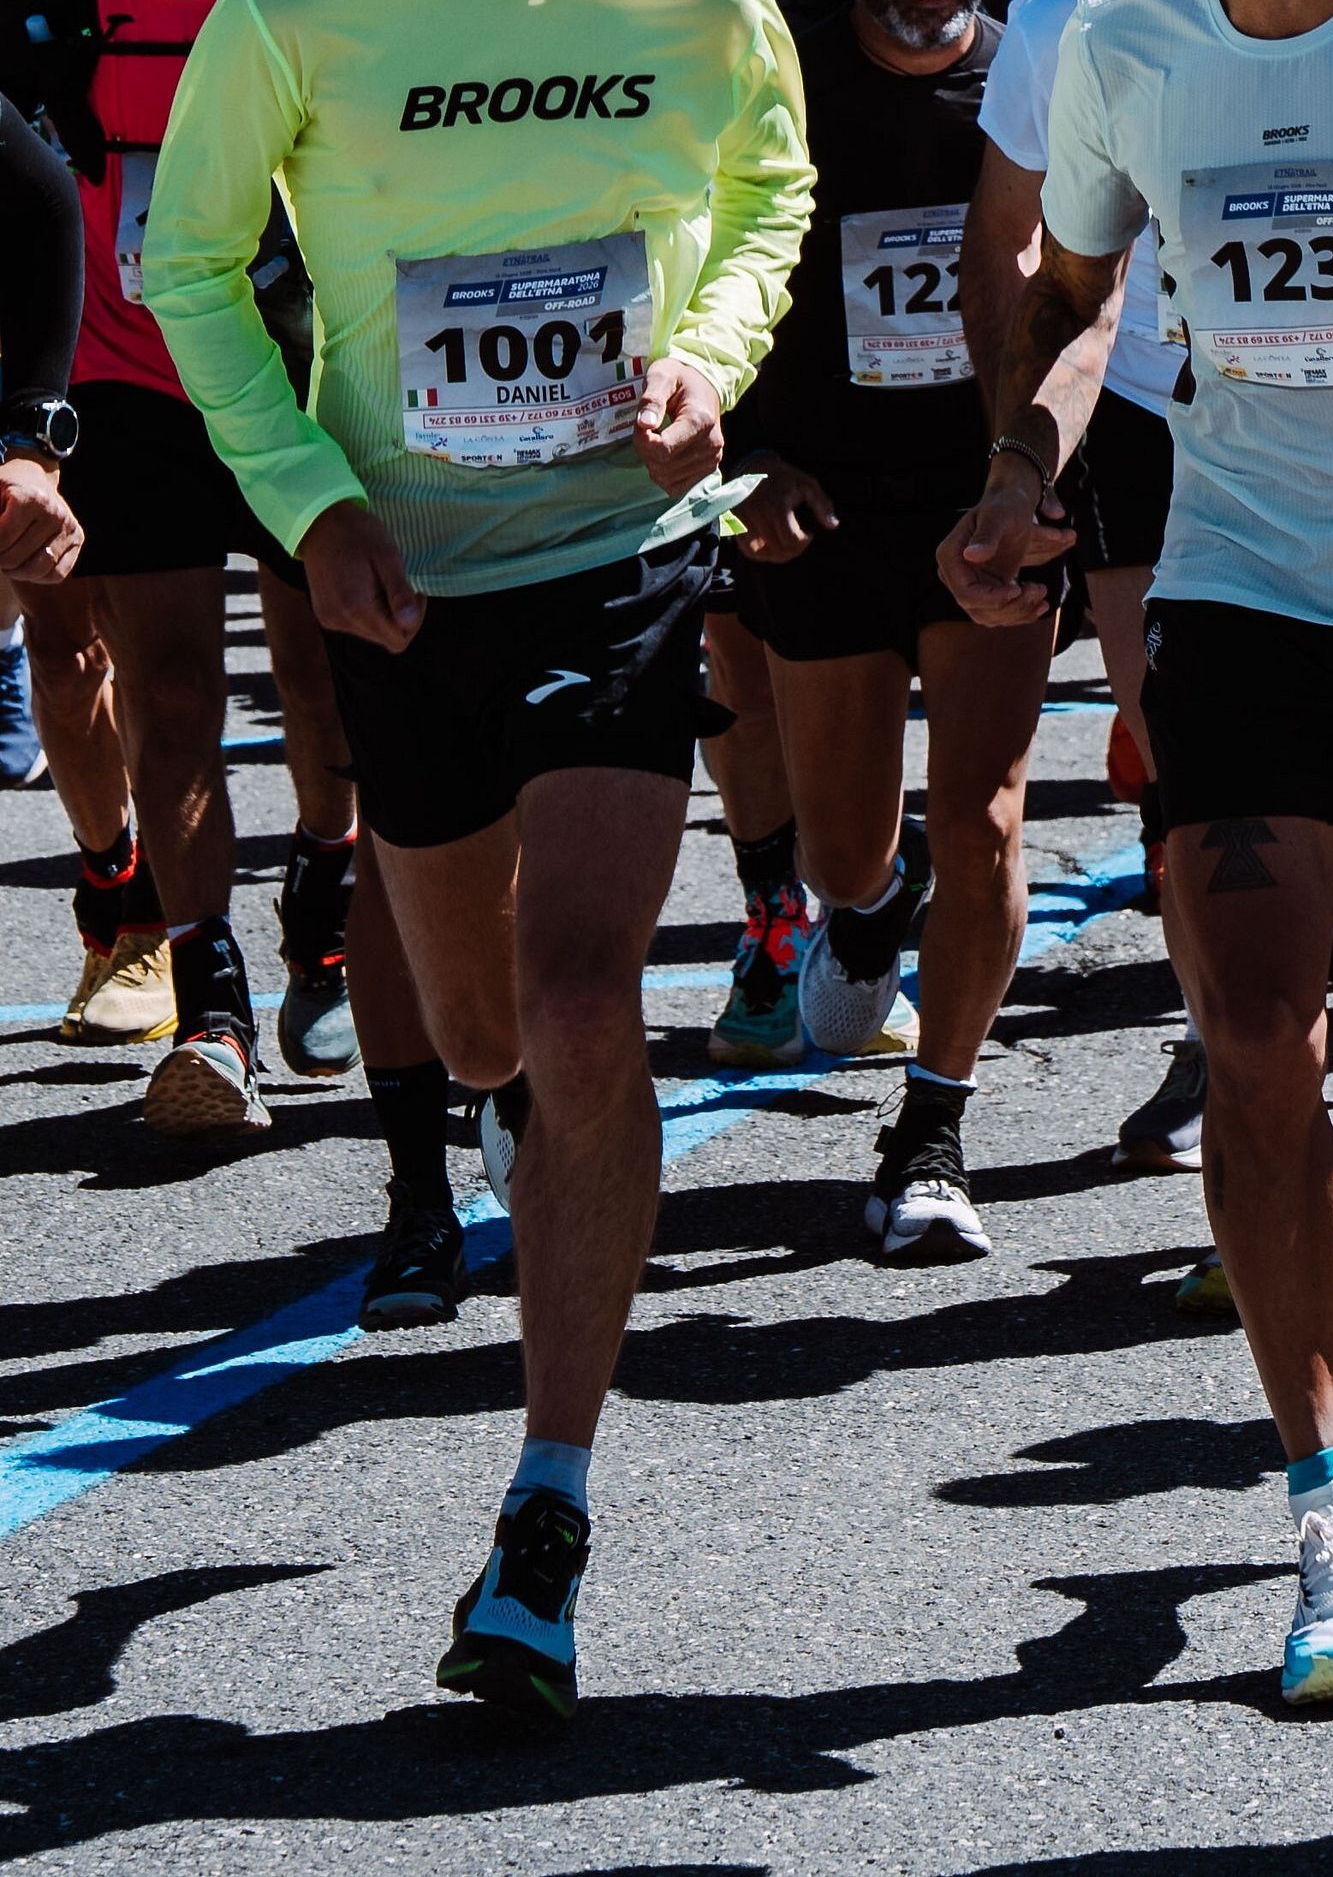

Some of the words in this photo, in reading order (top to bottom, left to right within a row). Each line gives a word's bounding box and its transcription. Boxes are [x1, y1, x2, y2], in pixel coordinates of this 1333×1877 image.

[399, 74, 656, 132] BROOKS
[1262, 124, 1310, 141] BROOKS
[1229, 201, 1269, 212] BROOKS
[1282, 201, 1331, 212] DELL'ETNA
[884, 234, 917, 243] BROOKS
[508, 287, 563, 299] DELL'ETNA
[577, 280, 599, 292] 2026
[511, 272, 600, 291] SUPERMARATONA
[452, 289, 495, 300] BROOKS
[544, 296, 596, 311] OFF-ROAD
[424, 310, 625, 383] 1001
[496, 383, 571, 405] DANIEL
